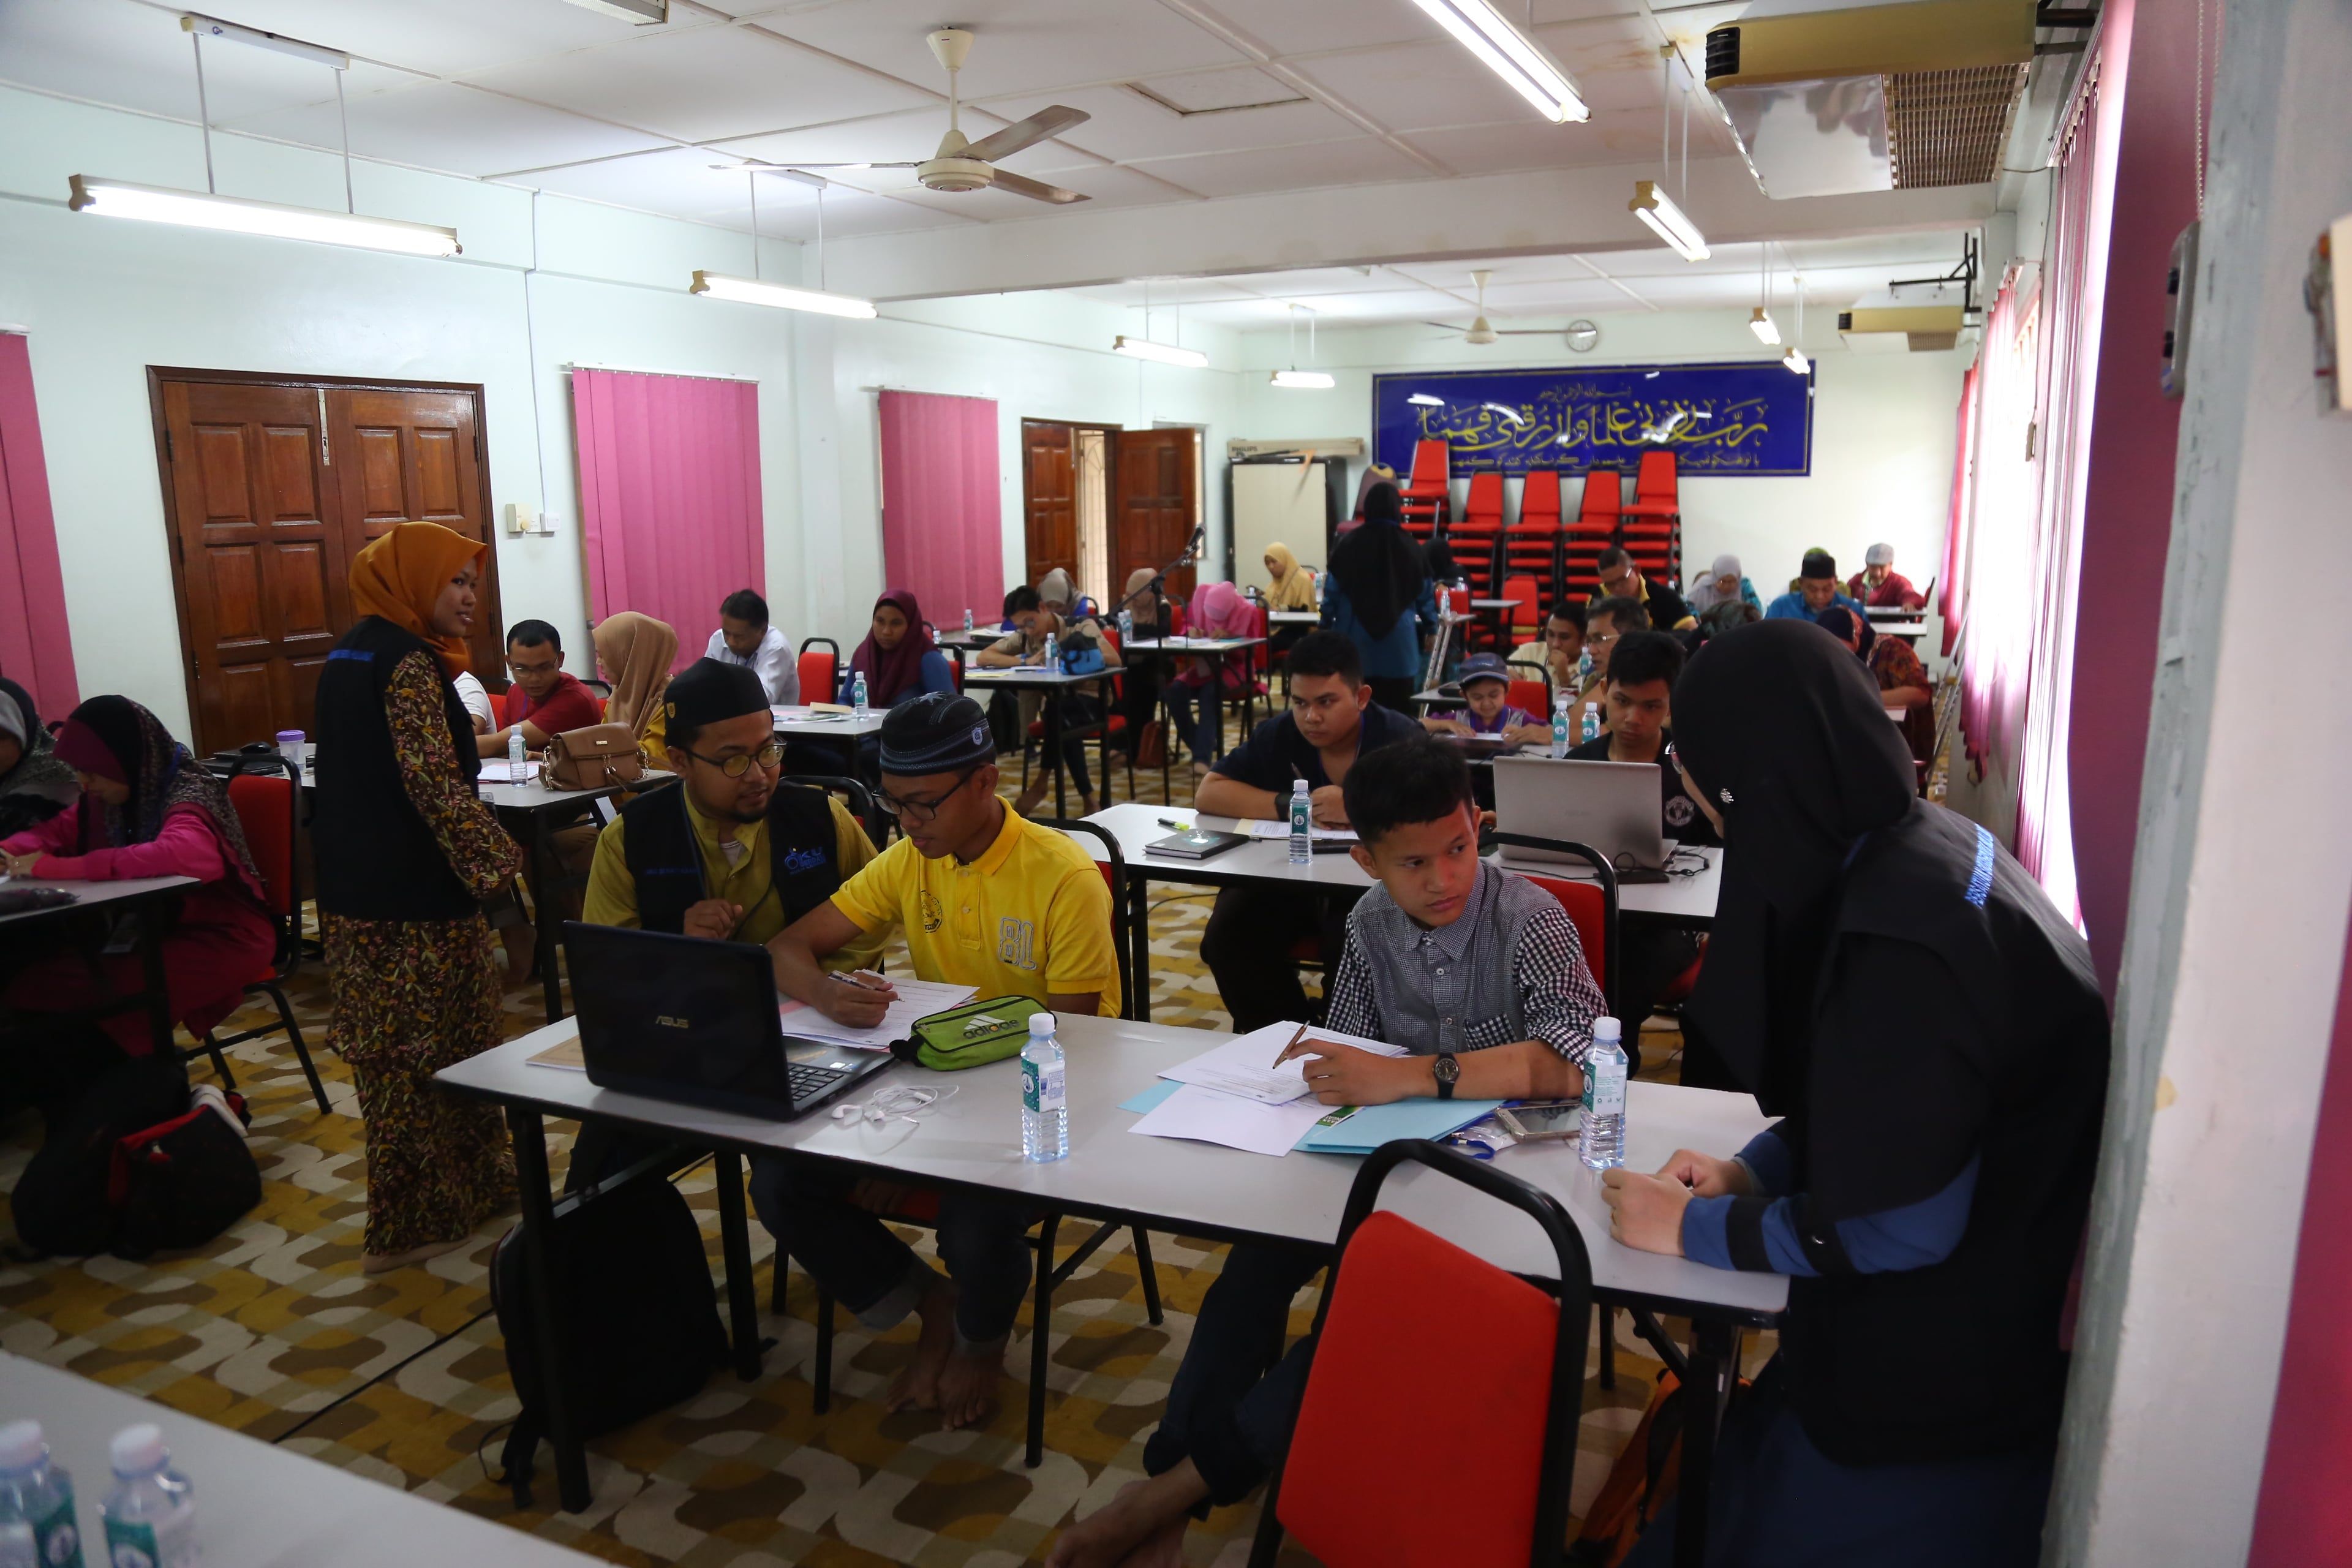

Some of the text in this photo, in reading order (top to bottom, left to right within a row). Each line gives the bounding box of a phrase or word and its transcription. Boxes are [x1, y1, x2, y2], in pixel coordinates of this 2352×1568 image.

[998, 916, 1037, 971] 81
[655, 1015, 689, 1029] ASUS
[963, 1019, 1019, 1040] adidas
